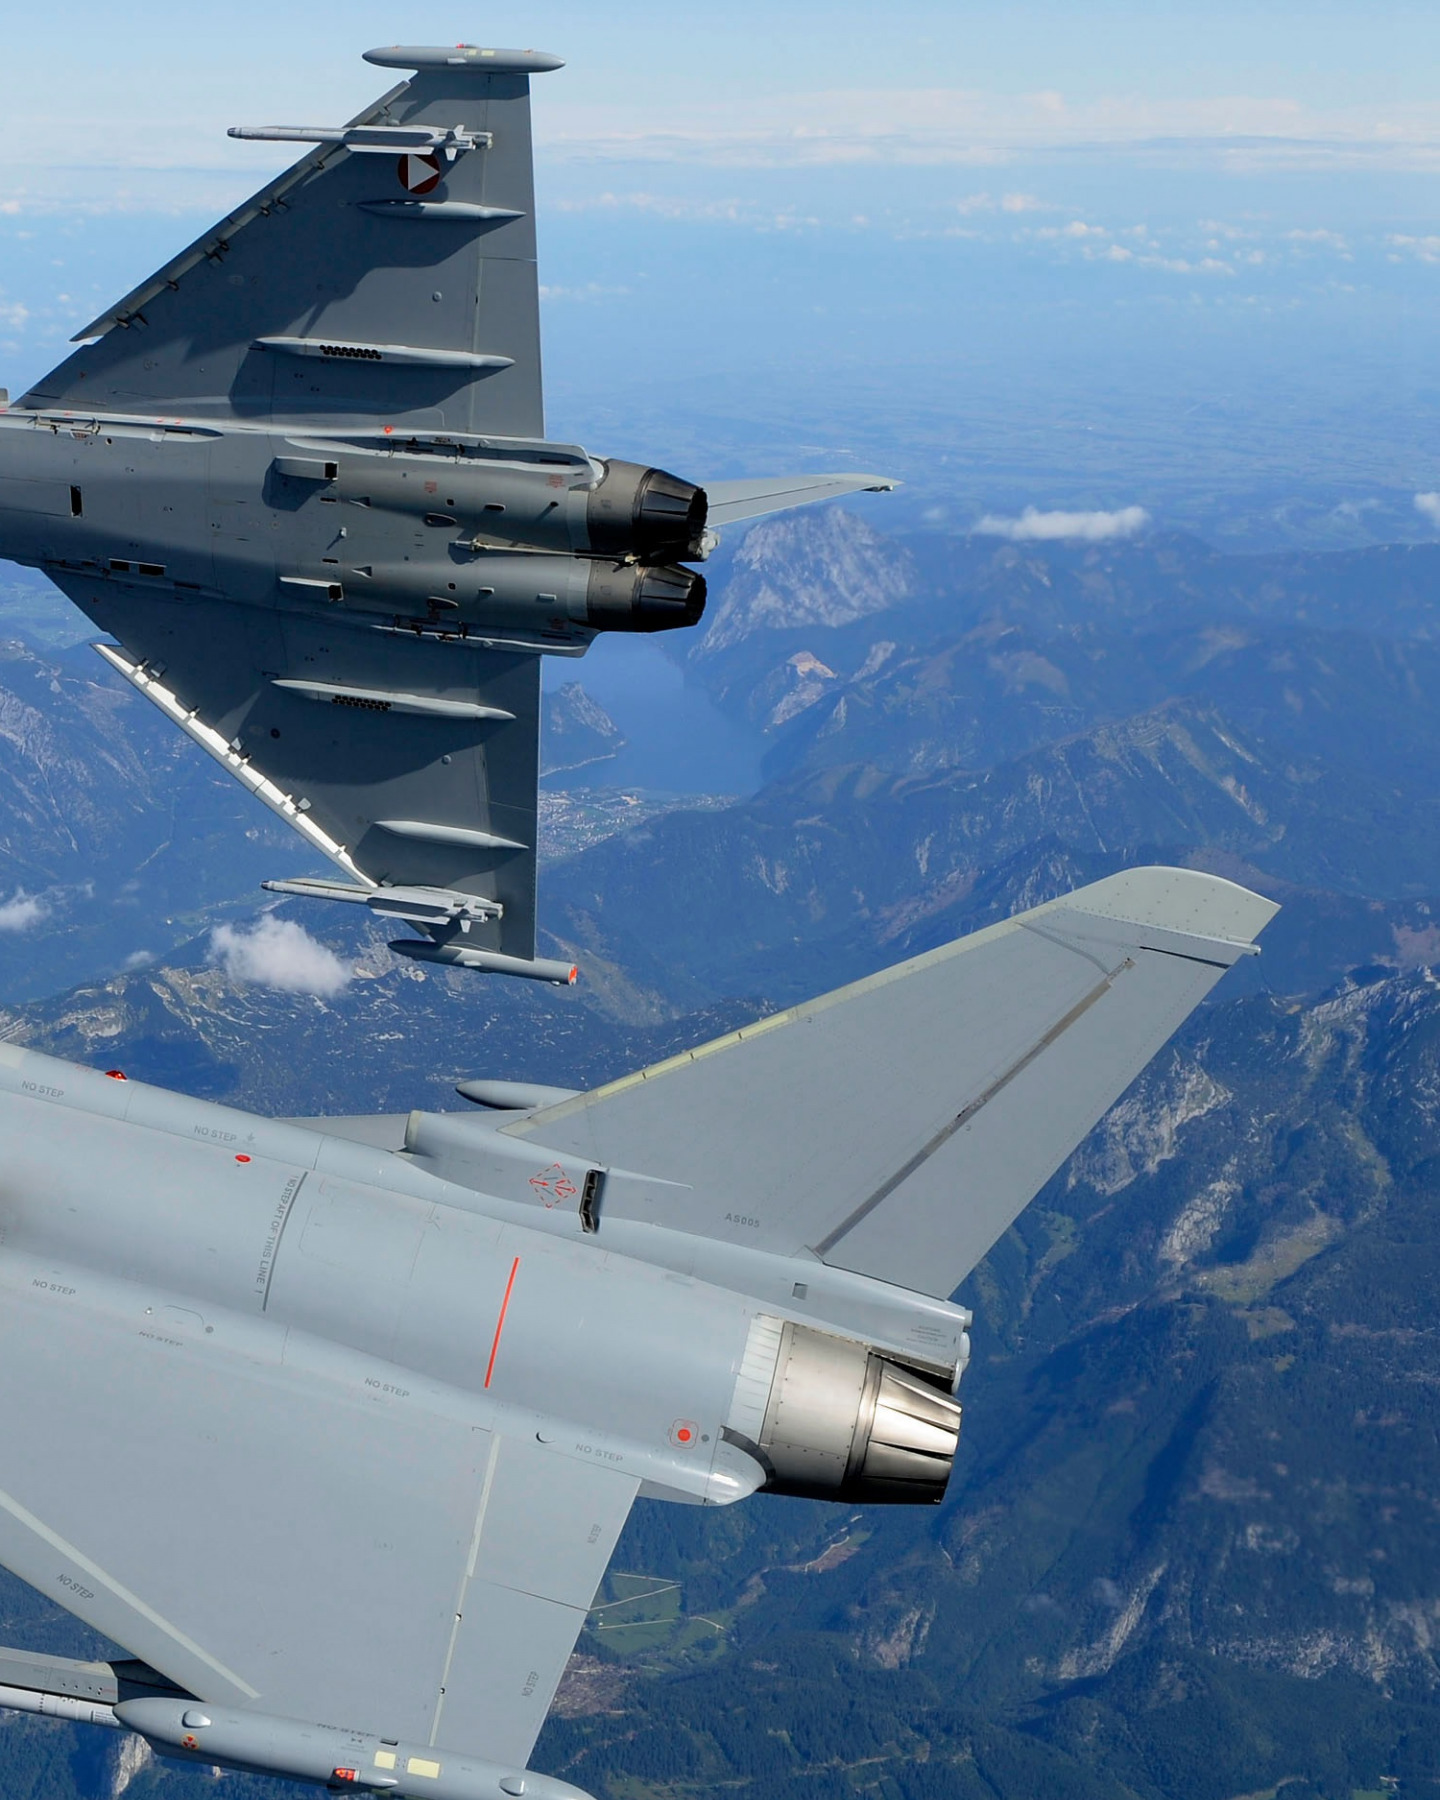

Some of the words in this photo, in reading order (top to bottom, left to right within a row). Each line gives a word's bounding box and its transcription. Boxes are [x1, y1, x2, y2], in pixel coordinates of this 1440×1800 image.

[21, 1080, 37, 1091] NO
[39, 1085, 64, 1098] STEP
[194, 1125, 209, 1136] NO
[211, 1129, 237, 1142] STEP
[274, 1203, 285, 1219] AFT
[270, 1220, 280, 1235] OF
[263, 1235, 276, 1258] THIS
[256, 1260, 269, 1284] LINE
[32, 1279, 47, 1288] NO
[50, 1284, 76, 1295] STEP
[364, 1377, 381, 1388] NO
[383, 1384, 410, 1398] STEP
[576, 1444, 592, 1453] NO
[595, 1449, 623, 1461] STEP
[57, 1574, 72, 1586] NO
[70, 1583, 94, 1599] STEP
